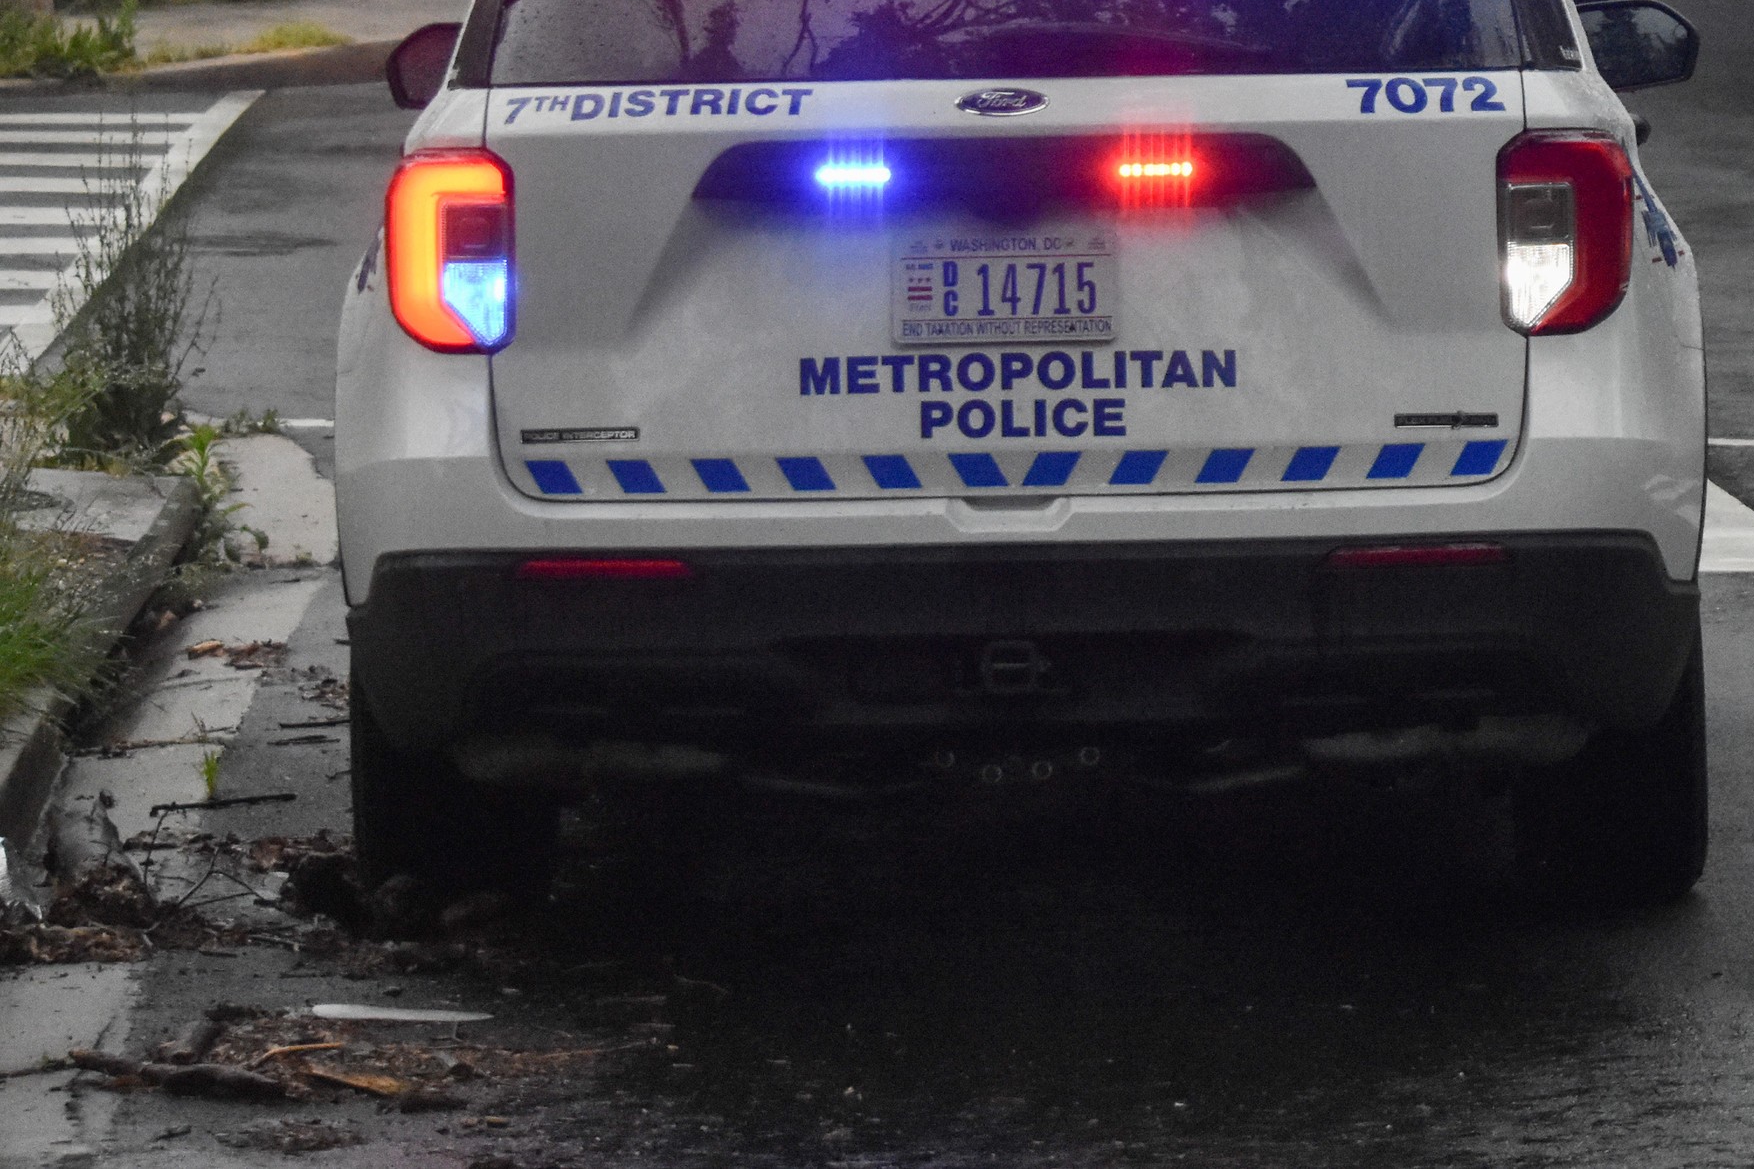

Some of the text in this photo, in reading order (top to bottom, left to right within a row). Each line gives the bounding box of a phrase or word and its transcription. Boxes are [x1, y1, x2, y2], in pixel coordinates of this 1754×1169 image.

[570, 88, 814, 122] DISTRICT
[1346, 76, 1507, 114] 7072
[976, 262, 1097, 317] 14715
[975, 320, 1020, 335] WITHOUT
[799, 349, 1237, 394] METROPOLITAN
[920, 398, 1127, 439] POLICE
